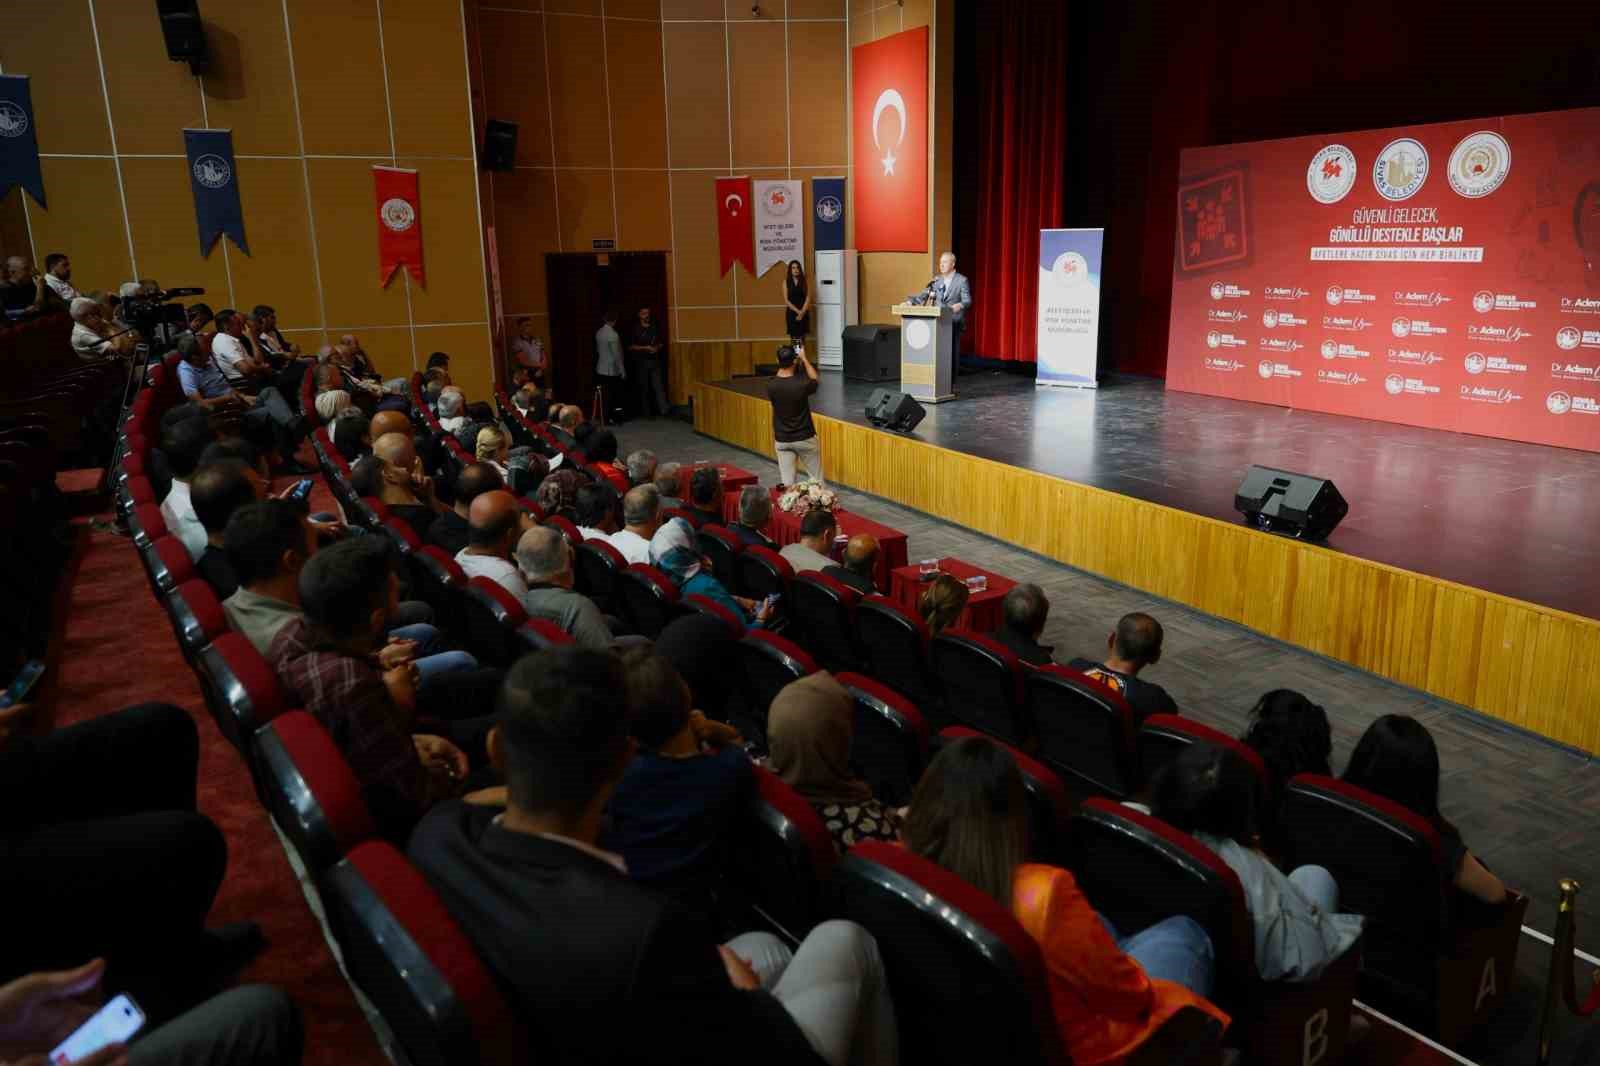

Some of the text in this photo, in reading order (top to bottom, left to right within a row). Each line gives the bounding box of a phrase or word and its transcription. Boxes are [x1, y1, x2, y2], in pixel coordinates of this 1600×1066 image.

[1353, 206, 1439, 224] GÜVENLİ GELECEK,
[1329, 225, 1463, 245] GÖNÜLLÜ DESTEKLE BAŞLAR
[1405, 292, 1428, 300] Adem
[1561, 298, 1575, 307] Dr.
[1468, 325, 1478, 333] Dr.
[1479, 325, 1506, 335] Adem
[1398, 350, 1421, 359] Adem
[1551, 362, 1594, 375] Dr. Adem
[1460, 385, 1471, 394] Dr.
[1471, 386, 1497, 397] Adem
[1474, 957, 1497, 1011] A
[1303, 1007, 1329, 1065] B
